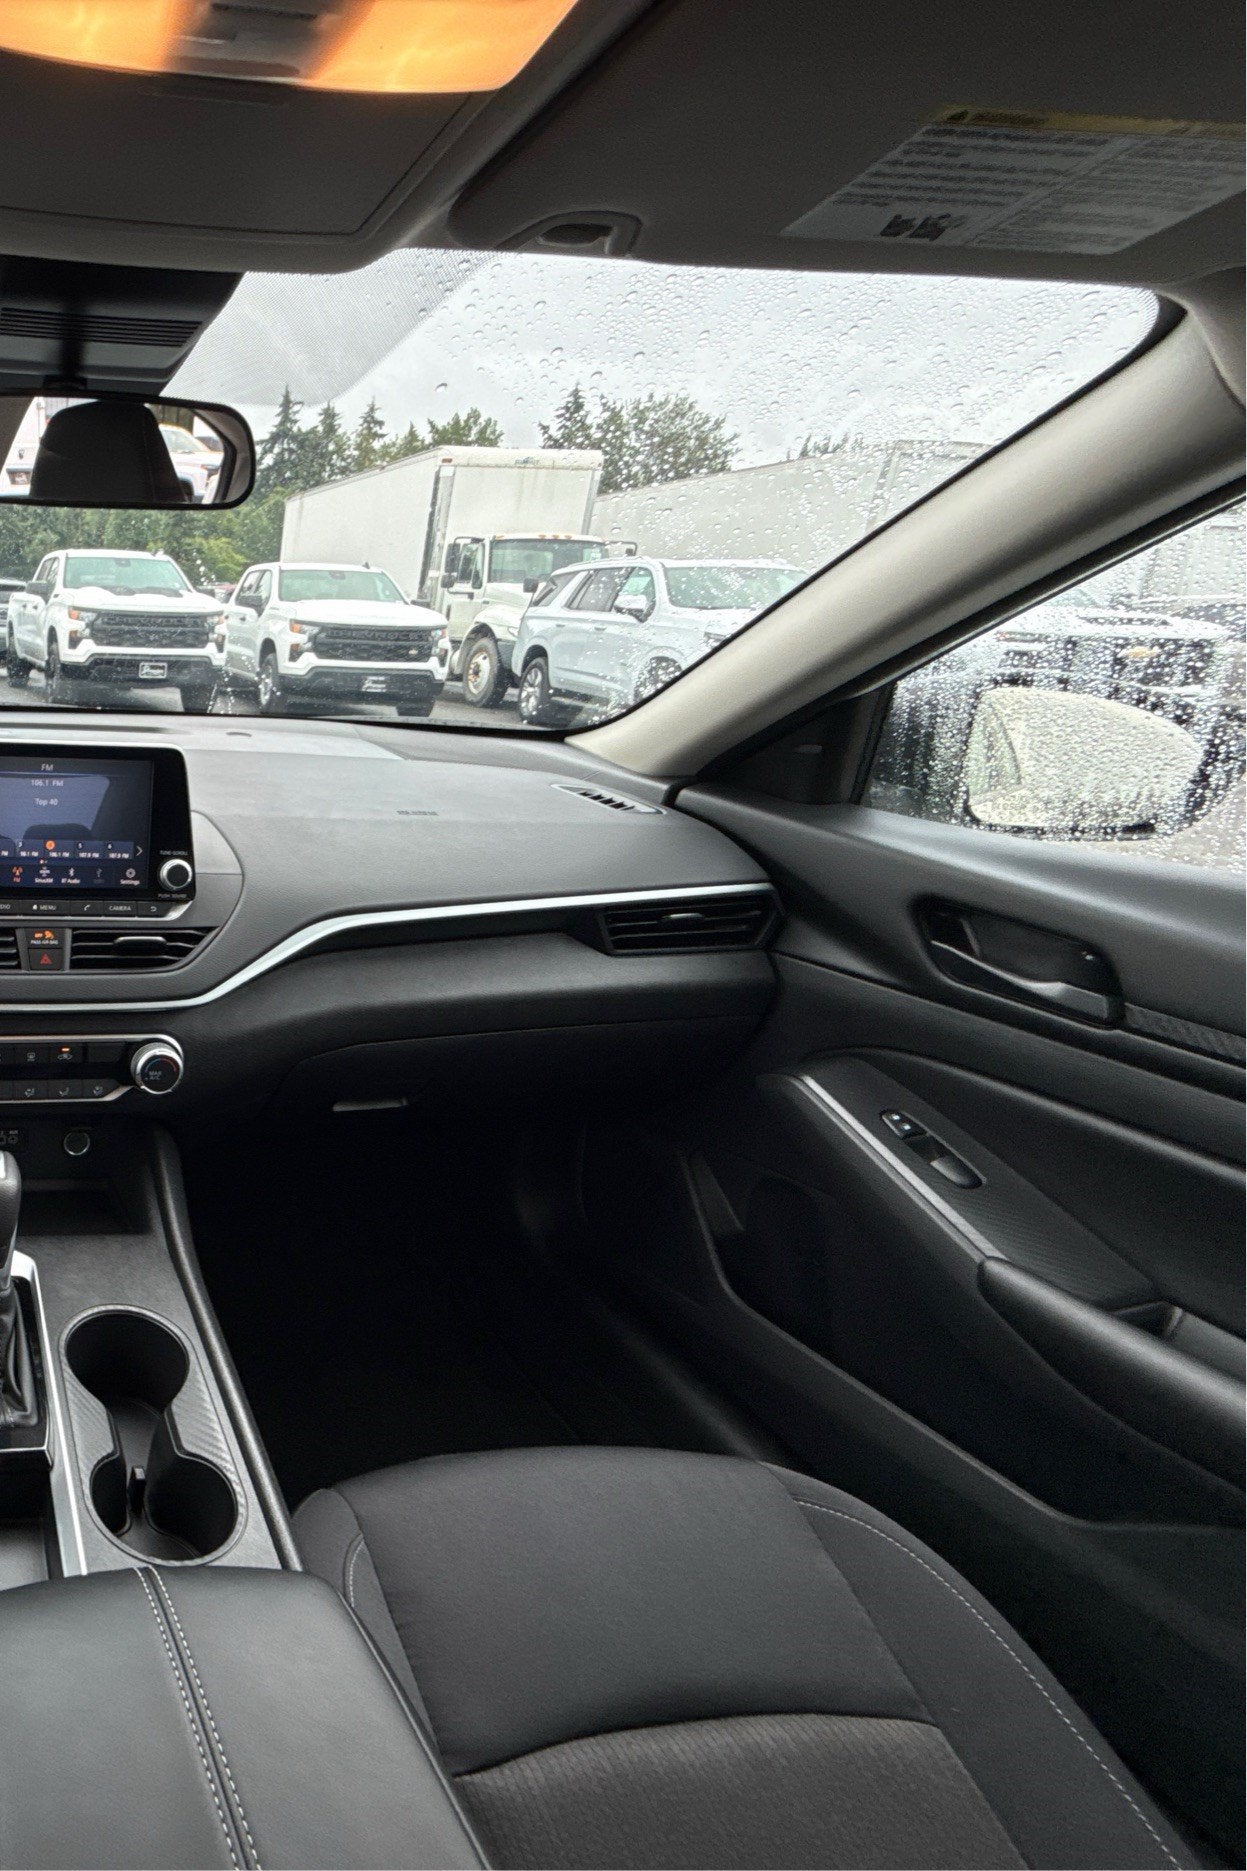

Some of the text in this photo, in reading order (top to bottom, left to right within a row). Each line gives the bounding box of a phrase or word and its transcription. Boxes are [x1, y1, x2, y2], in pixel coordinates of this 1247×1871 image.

[40, 763, 54, 771] FM
[31, 779, 64, 787] 106.1 FM
[34, 798, 46, 806] Top
